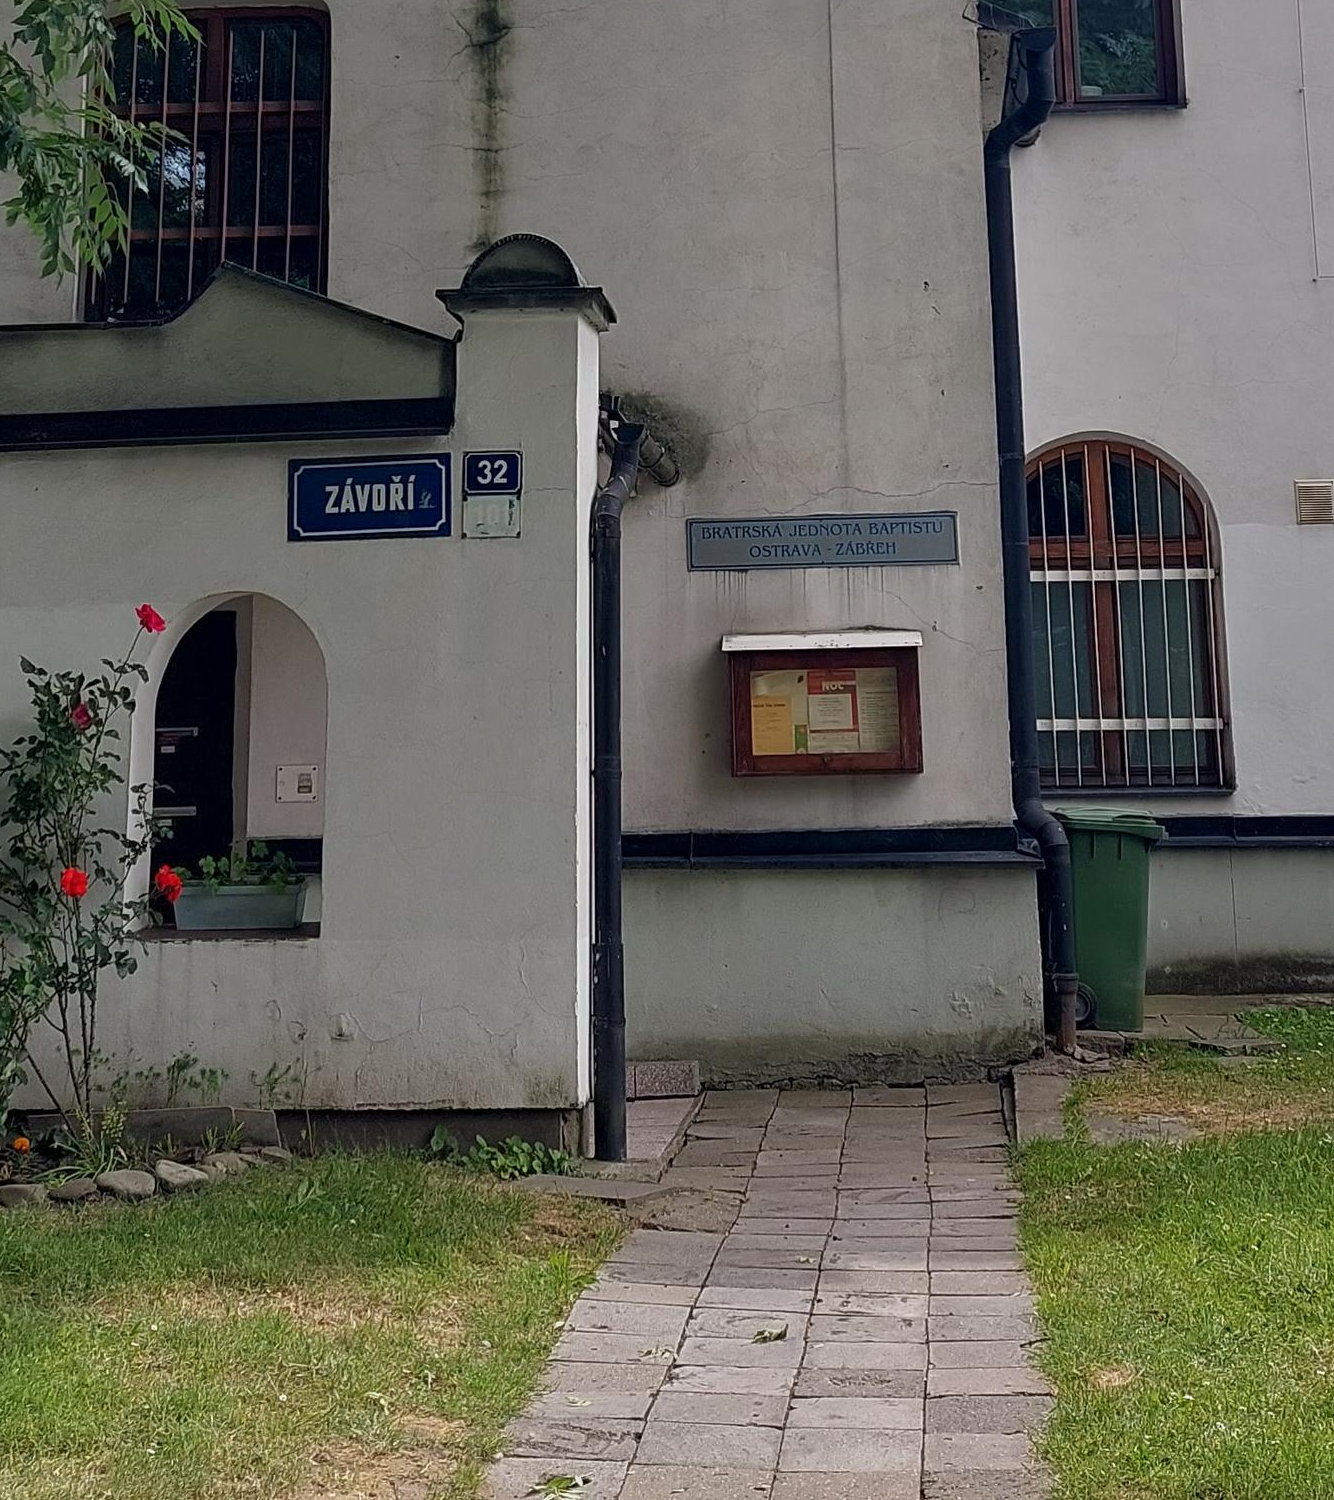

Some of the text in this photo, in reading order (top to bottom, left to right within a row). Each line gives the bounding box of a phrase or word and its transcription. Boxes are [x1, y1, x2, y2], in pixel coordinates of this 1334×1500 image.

[476, 460, 508, 485] 32
[324, 474, 416, 514] ZÁVOŘÍ
[701, 519, 943, 540] BRATRSKÁ JEDNOTA BAPTISTŮ
[749, 543, 822, 558] OSTRAVA
[836, 540, 896, 556] ZÁBŘEH
